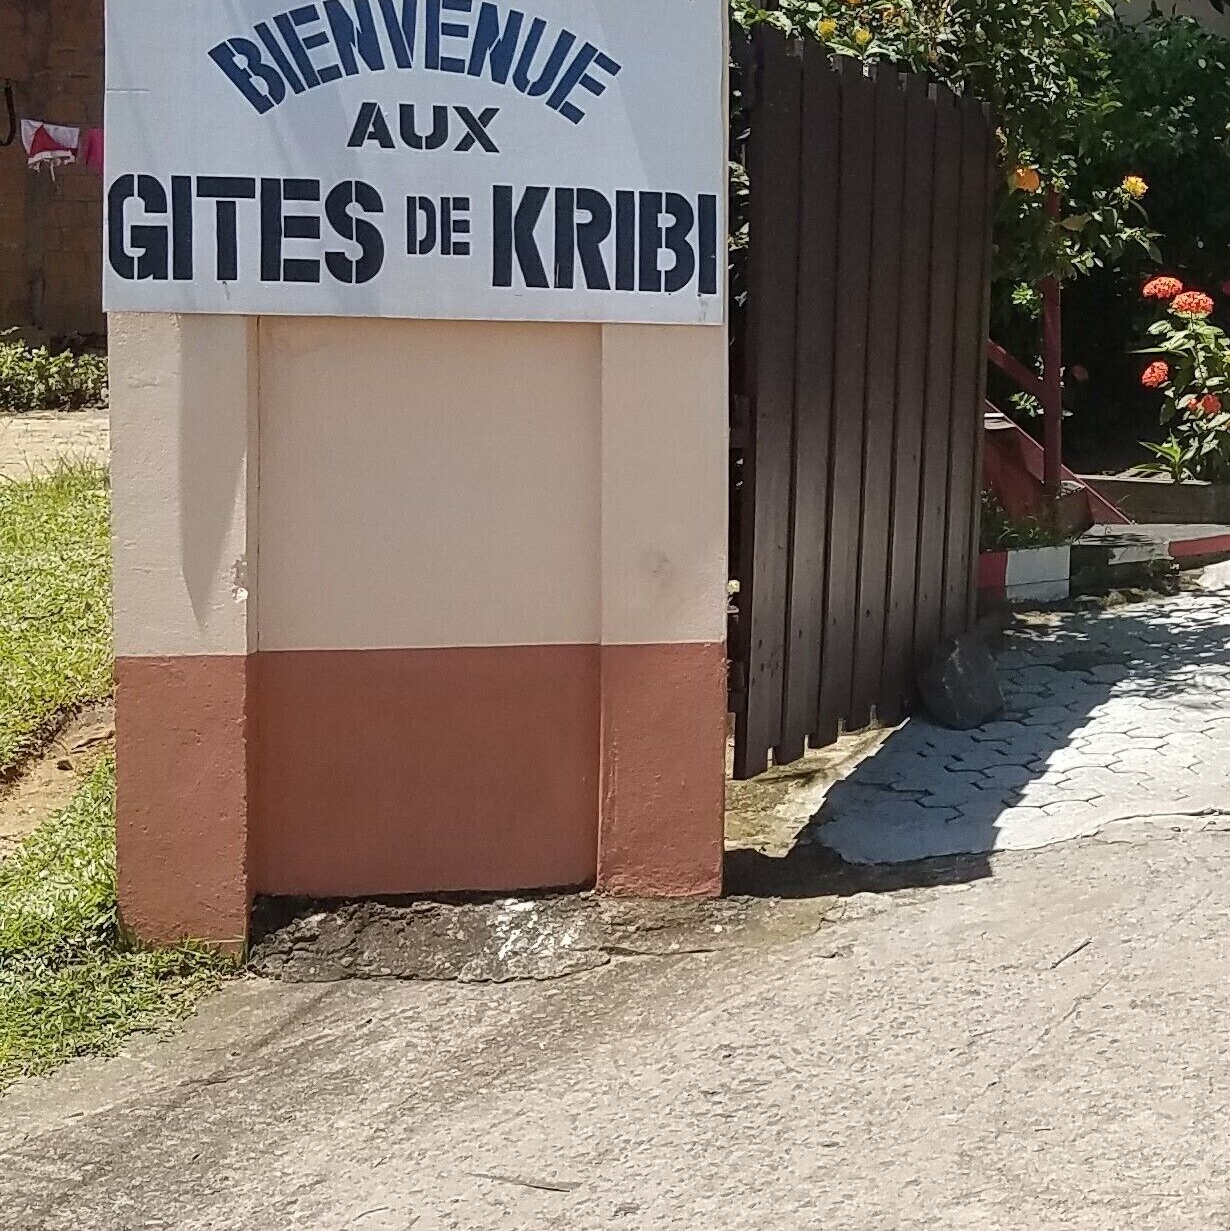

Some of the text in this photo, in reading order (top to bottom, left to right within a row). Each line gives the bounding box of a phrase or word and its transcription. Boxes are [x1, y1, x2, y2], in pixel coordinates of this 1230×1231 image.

[347, 101, 501, 153] AUX
[107, 174, 717, 294] GITES DE KRIBI
